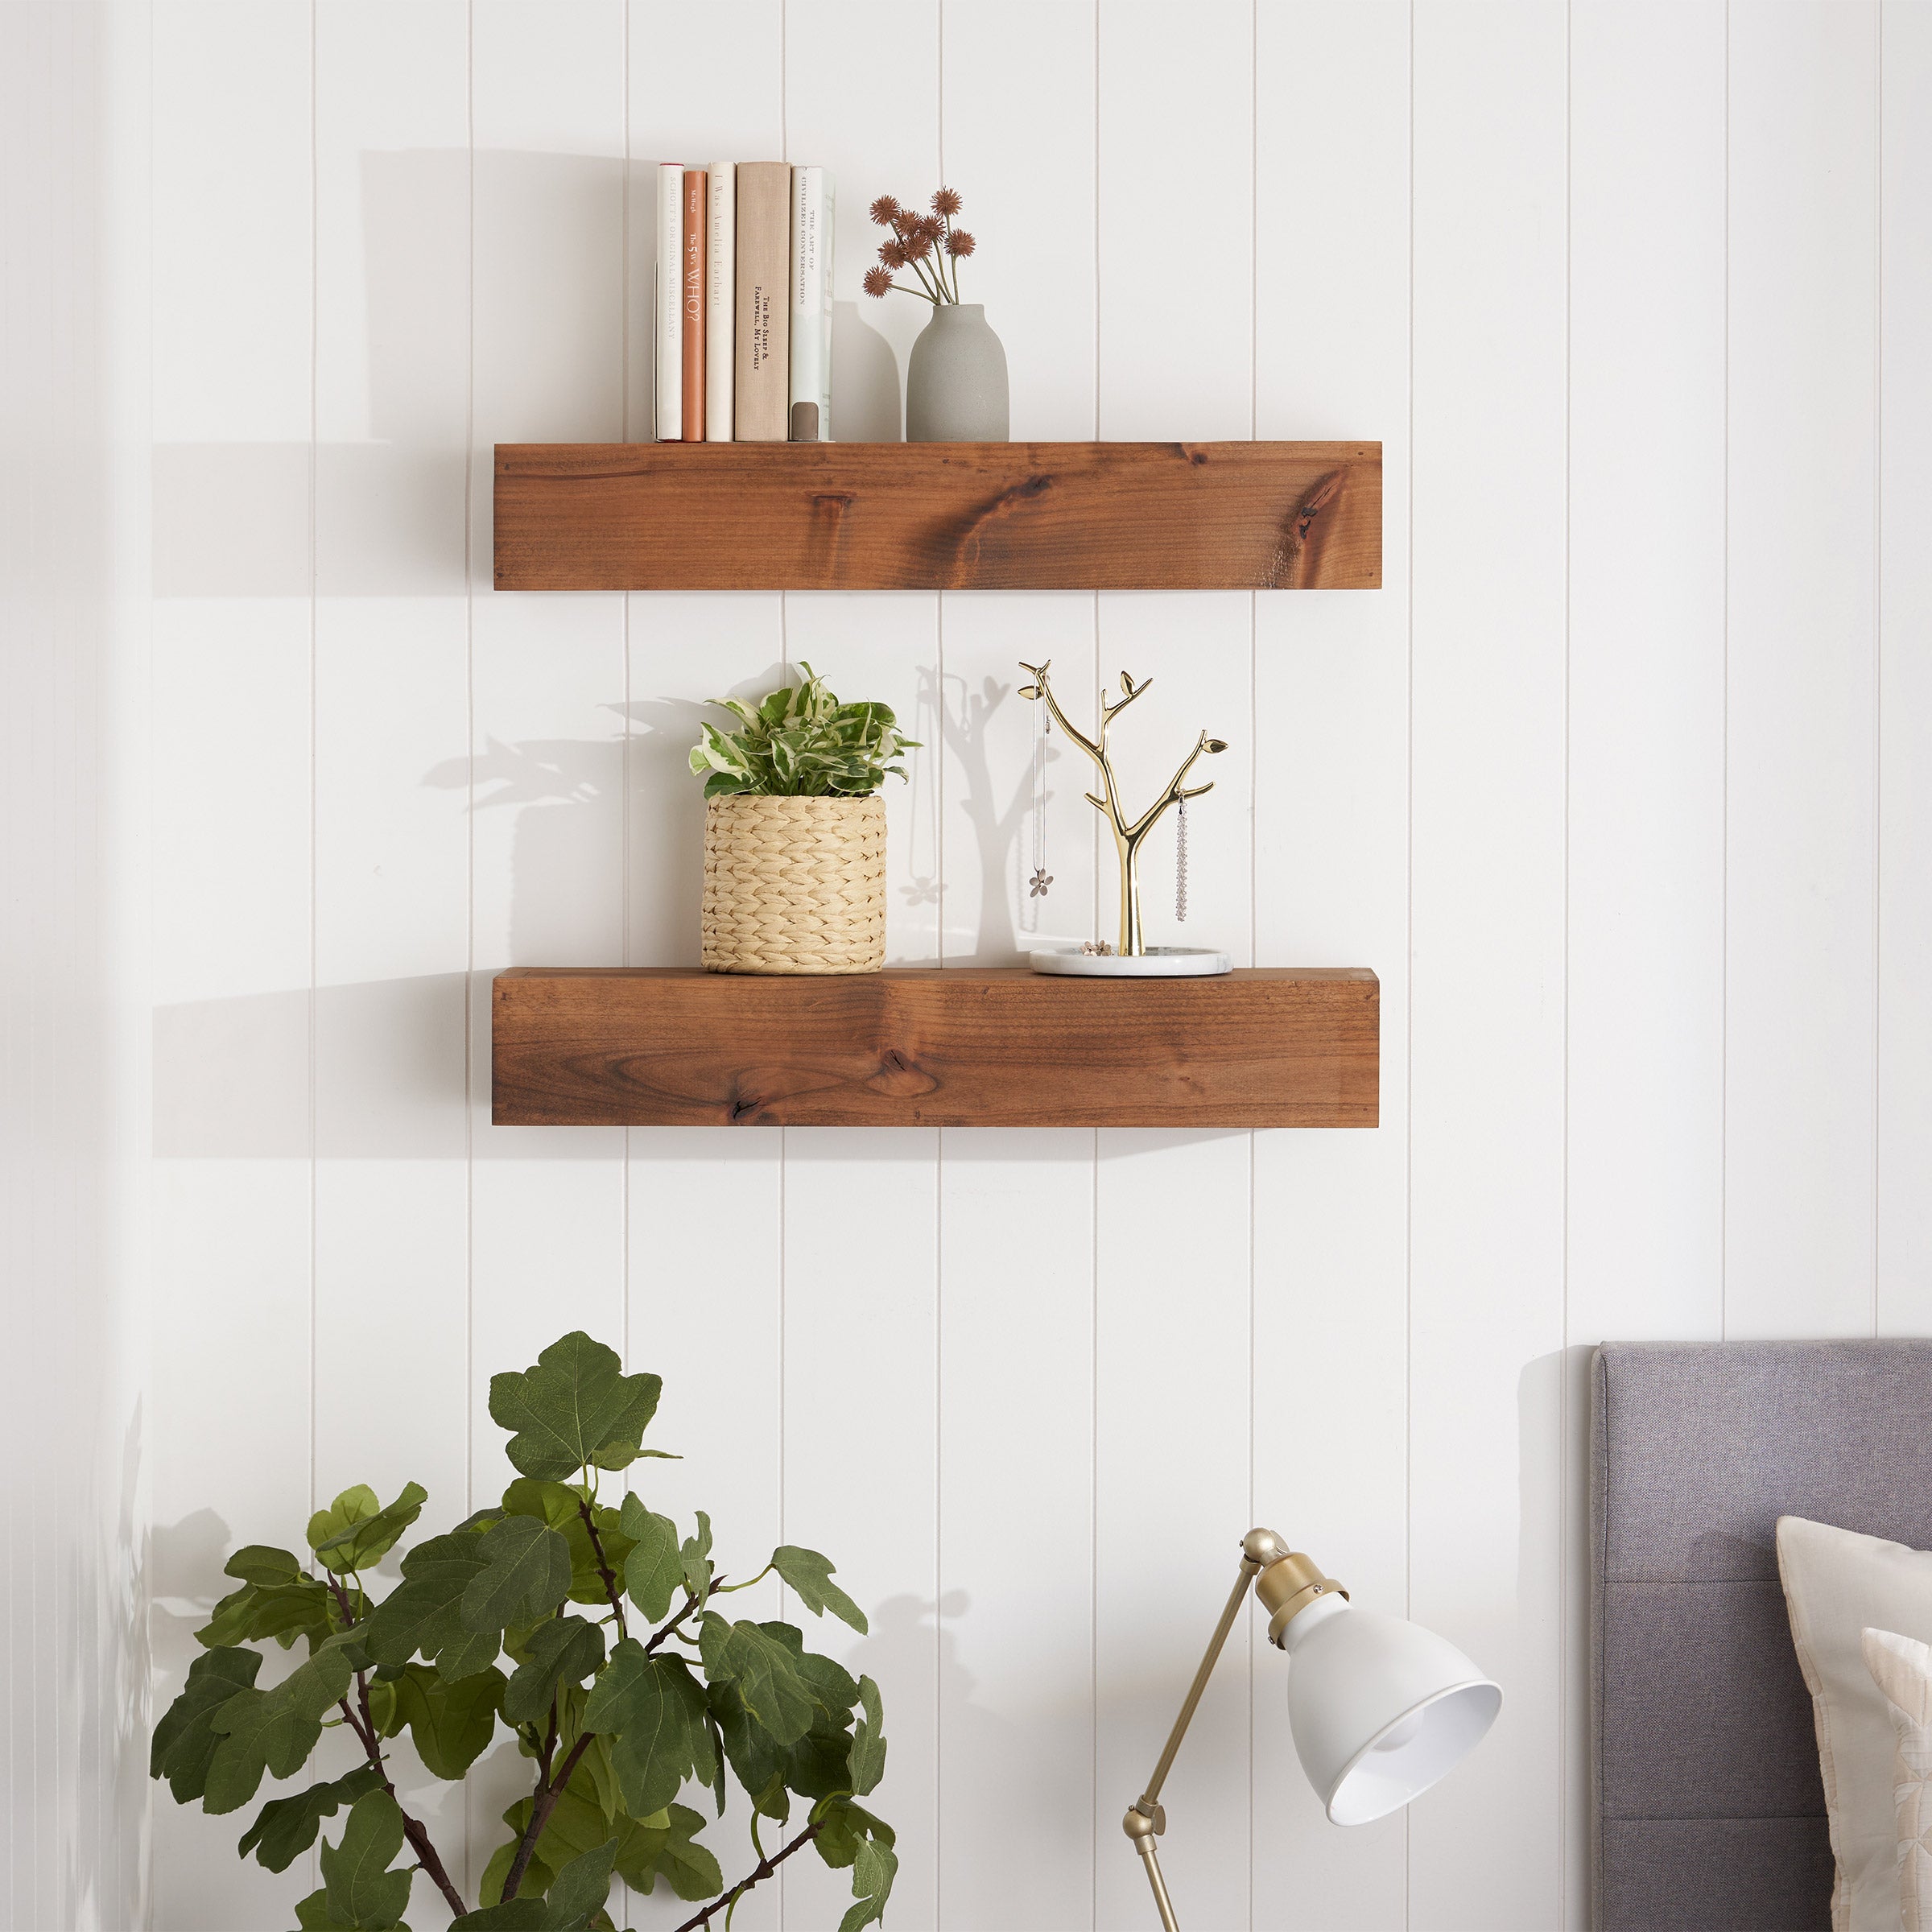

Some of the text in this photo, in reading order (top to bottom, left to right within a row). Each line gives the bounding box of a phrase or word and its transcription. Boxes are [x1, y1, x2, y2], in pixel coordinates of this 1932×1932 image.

[715, 185, 723, 207] Was
[714, 214, 723, 254] Amelia
[714, 261, 722, 306] Earhart
[808, 258, 815, 270] OF
[687, 269, 700, 322] WHO?
